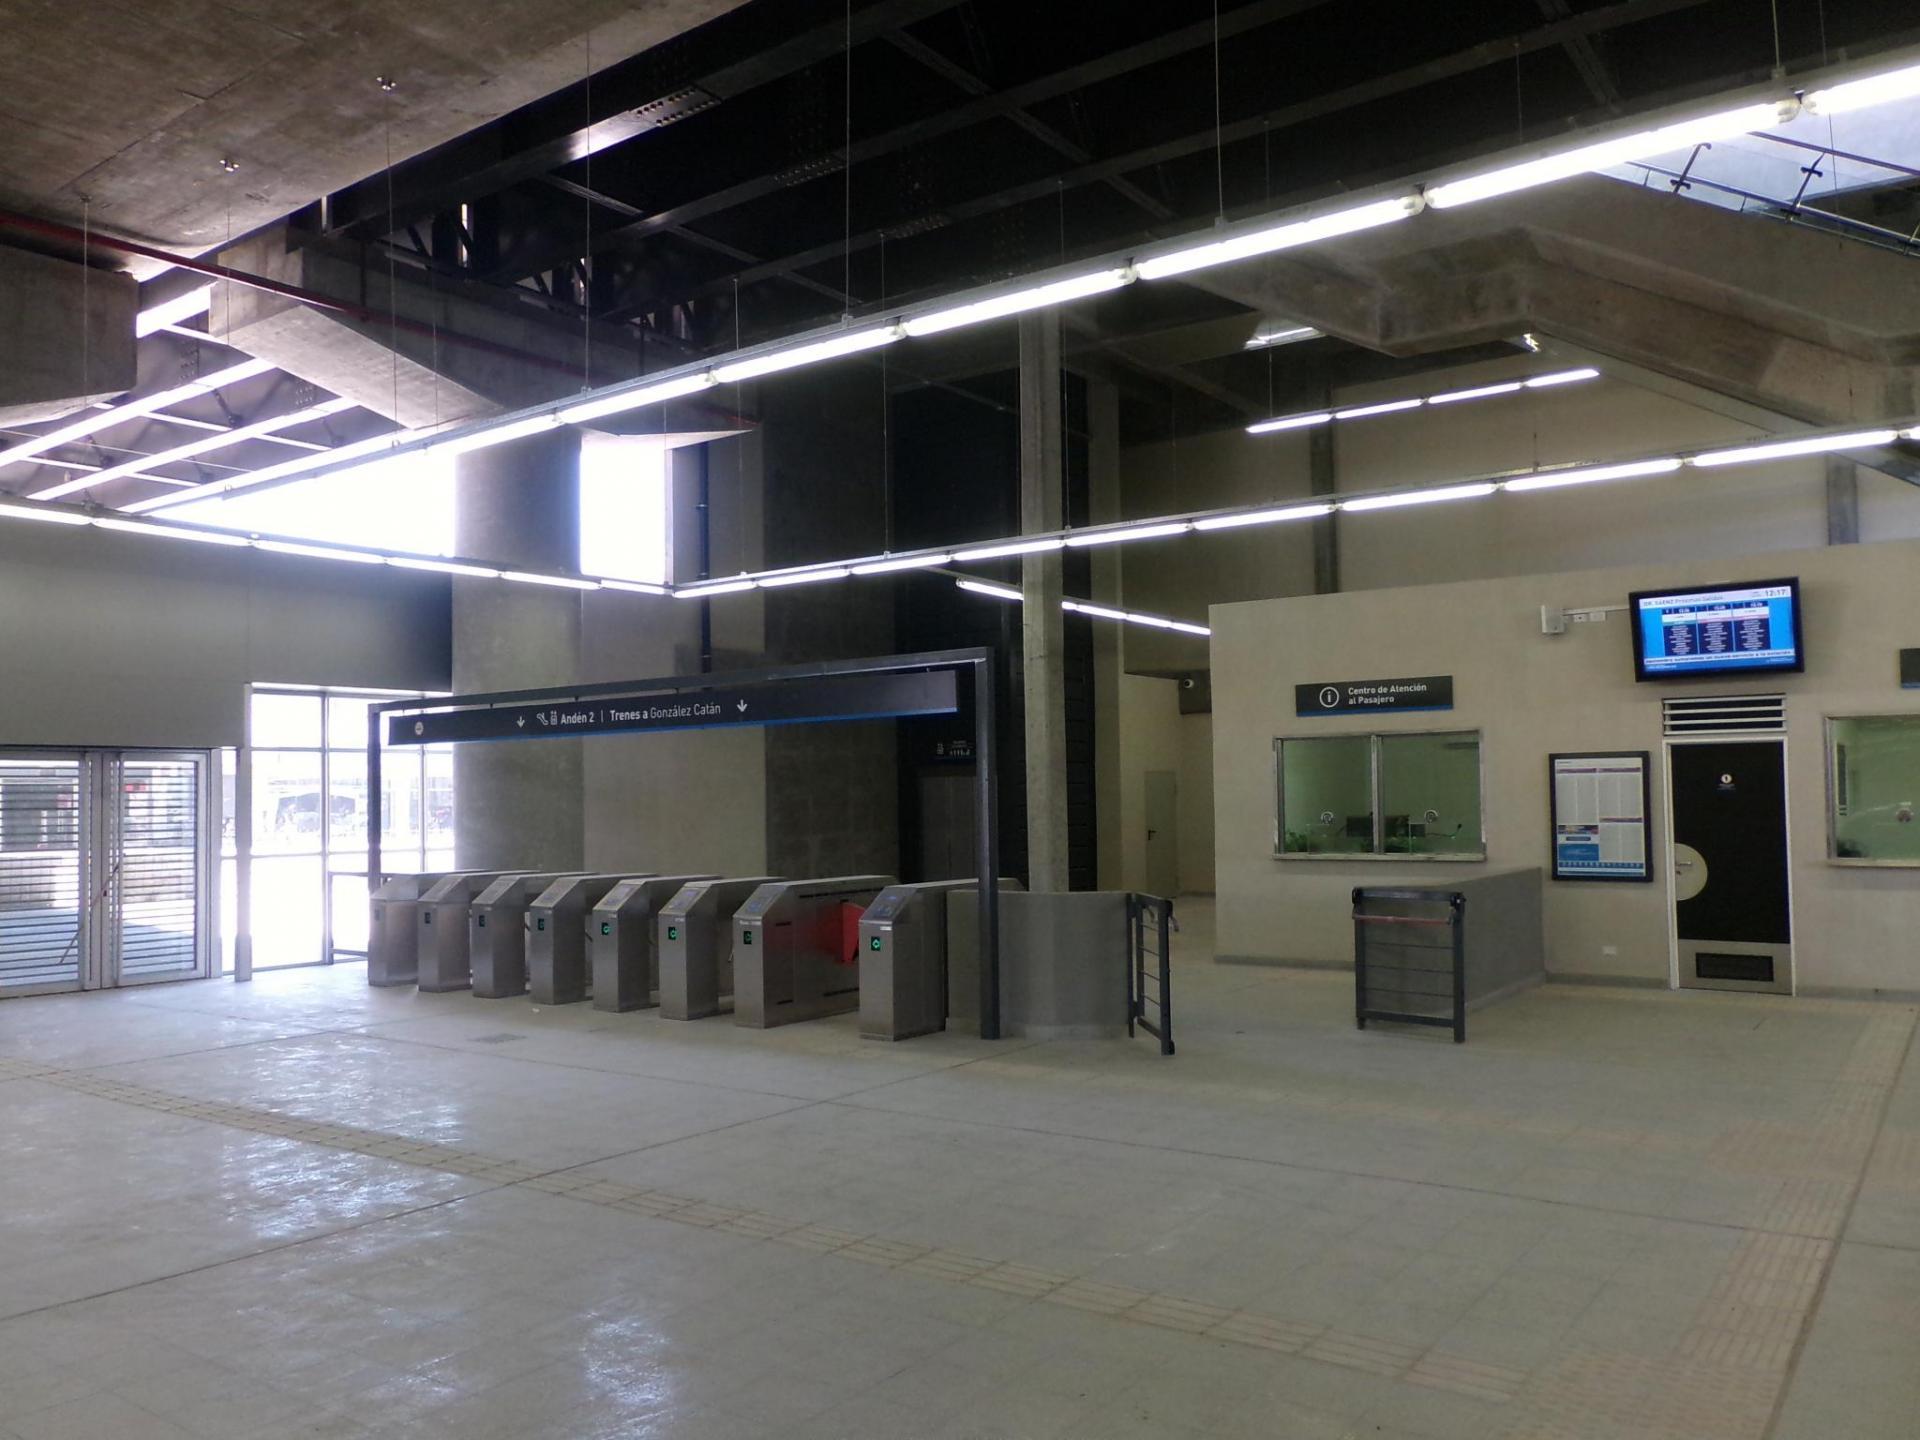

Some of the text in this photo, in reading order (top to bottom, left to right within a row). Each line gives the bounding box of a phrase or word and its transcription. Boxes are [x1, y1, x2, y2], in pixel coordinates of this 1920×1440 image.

[1764, 589, 1786, 597] 12:17
[1348, 683, 1427, 695] Centro de Atención
[1348, 696, 1395, 706] al Pasajero
[560, 702, 721, 725] Andén 2 Trenes a González Catán
